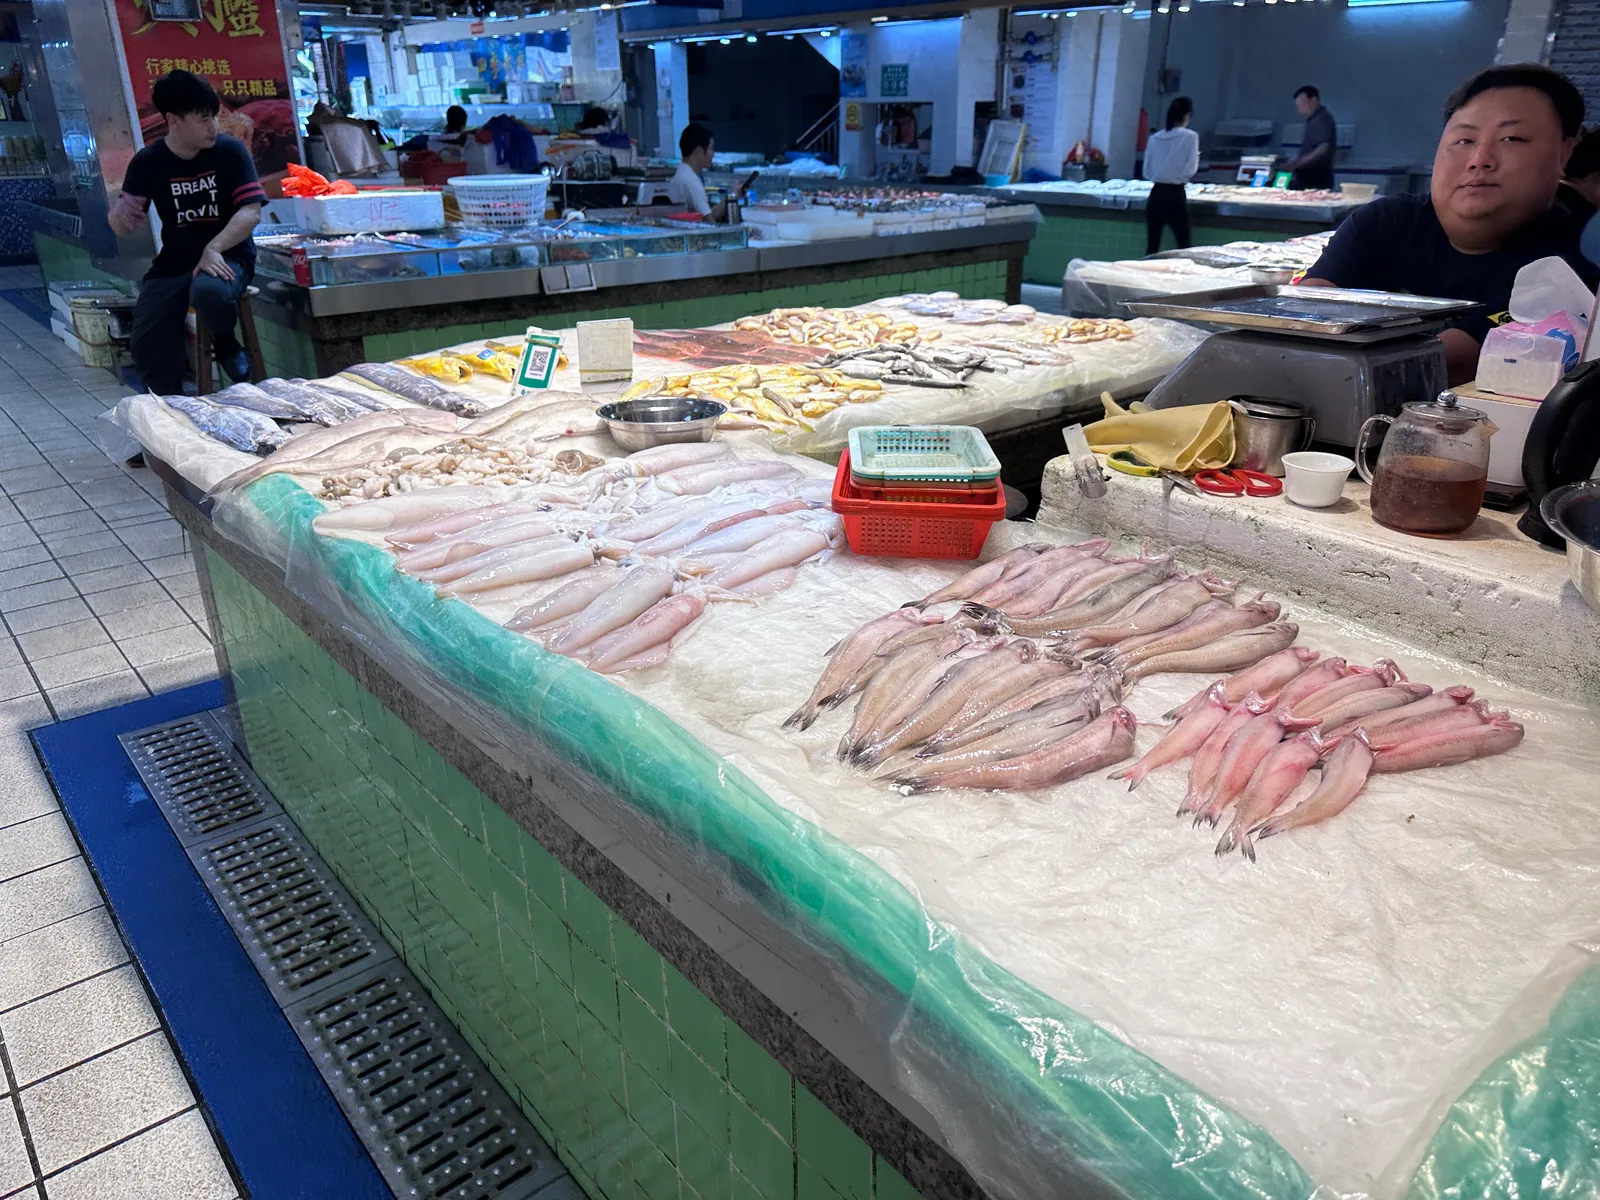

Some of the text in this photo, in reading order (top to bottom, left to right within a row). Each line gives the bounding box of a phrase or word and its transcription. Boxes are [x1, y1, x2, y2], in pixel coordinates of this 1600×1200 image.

[223, 79, 277, 96] 只只精品
[171, 175, 217, 195] BREAK
